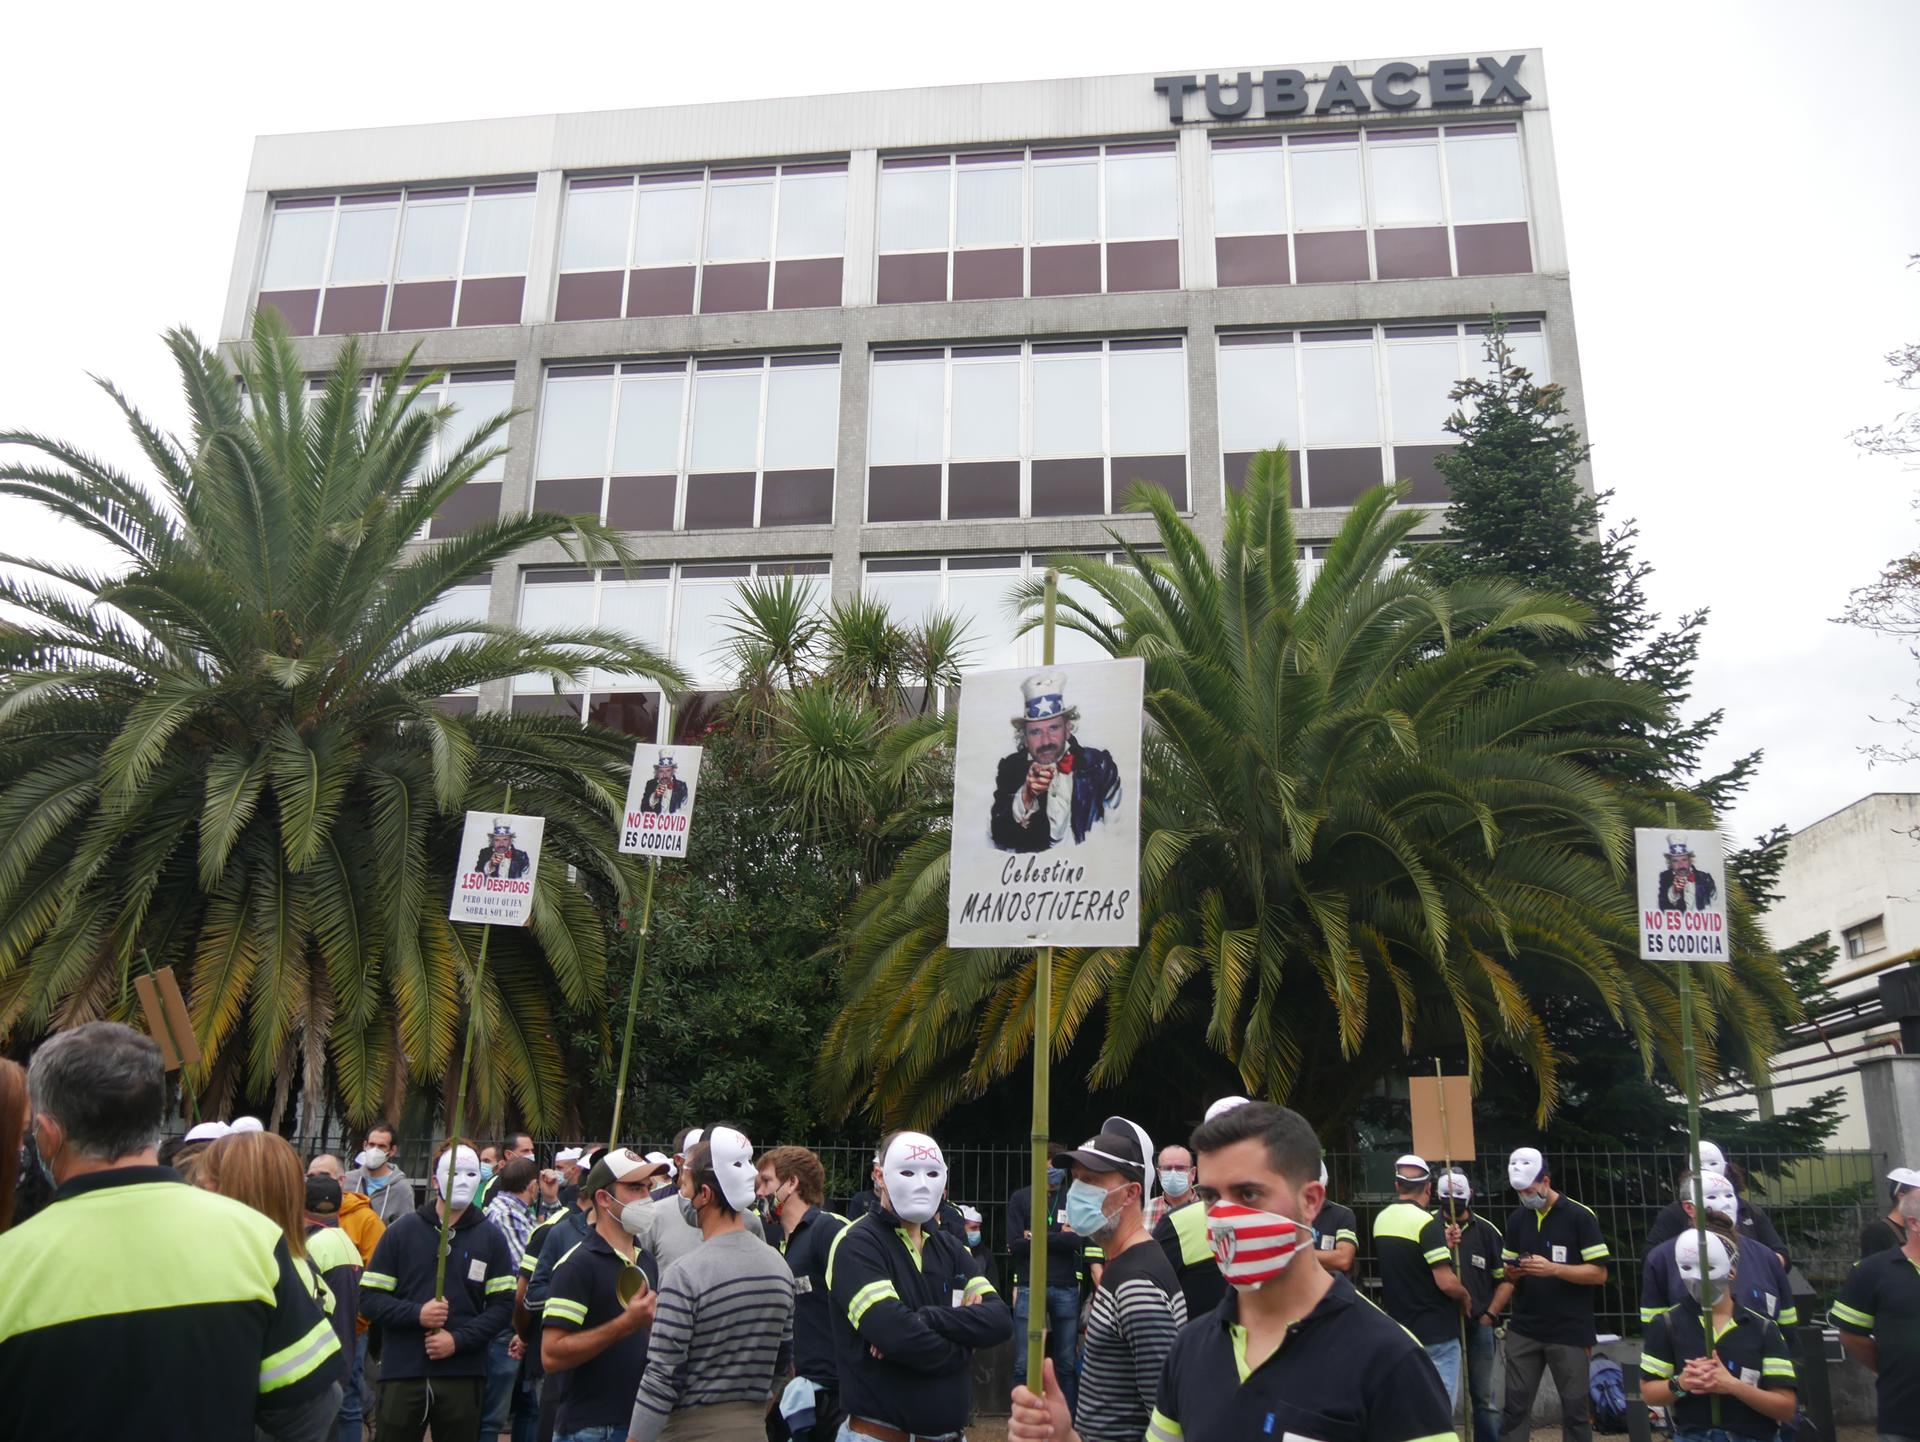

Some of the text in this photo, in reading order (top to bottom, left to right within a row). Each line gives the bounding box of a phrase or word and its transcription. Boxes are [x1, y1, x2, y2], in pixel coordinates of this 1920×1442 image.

[1154, 54, 1532, 125] TUBACEX
[627, 812, 686, 832] NO ES COVID
[625, 831, 682, 851] ES CODICIA
[1001, 855, 1083, 885] Celestino
[461, 873, 530, 894] 150 DESPIDOS
[960, 889, 1130, 925] MANOSTIJERAS
[1645, 911, 1722, 932] NO ES COVID
[1648, 934, 1722, 954] ES CODICIA
